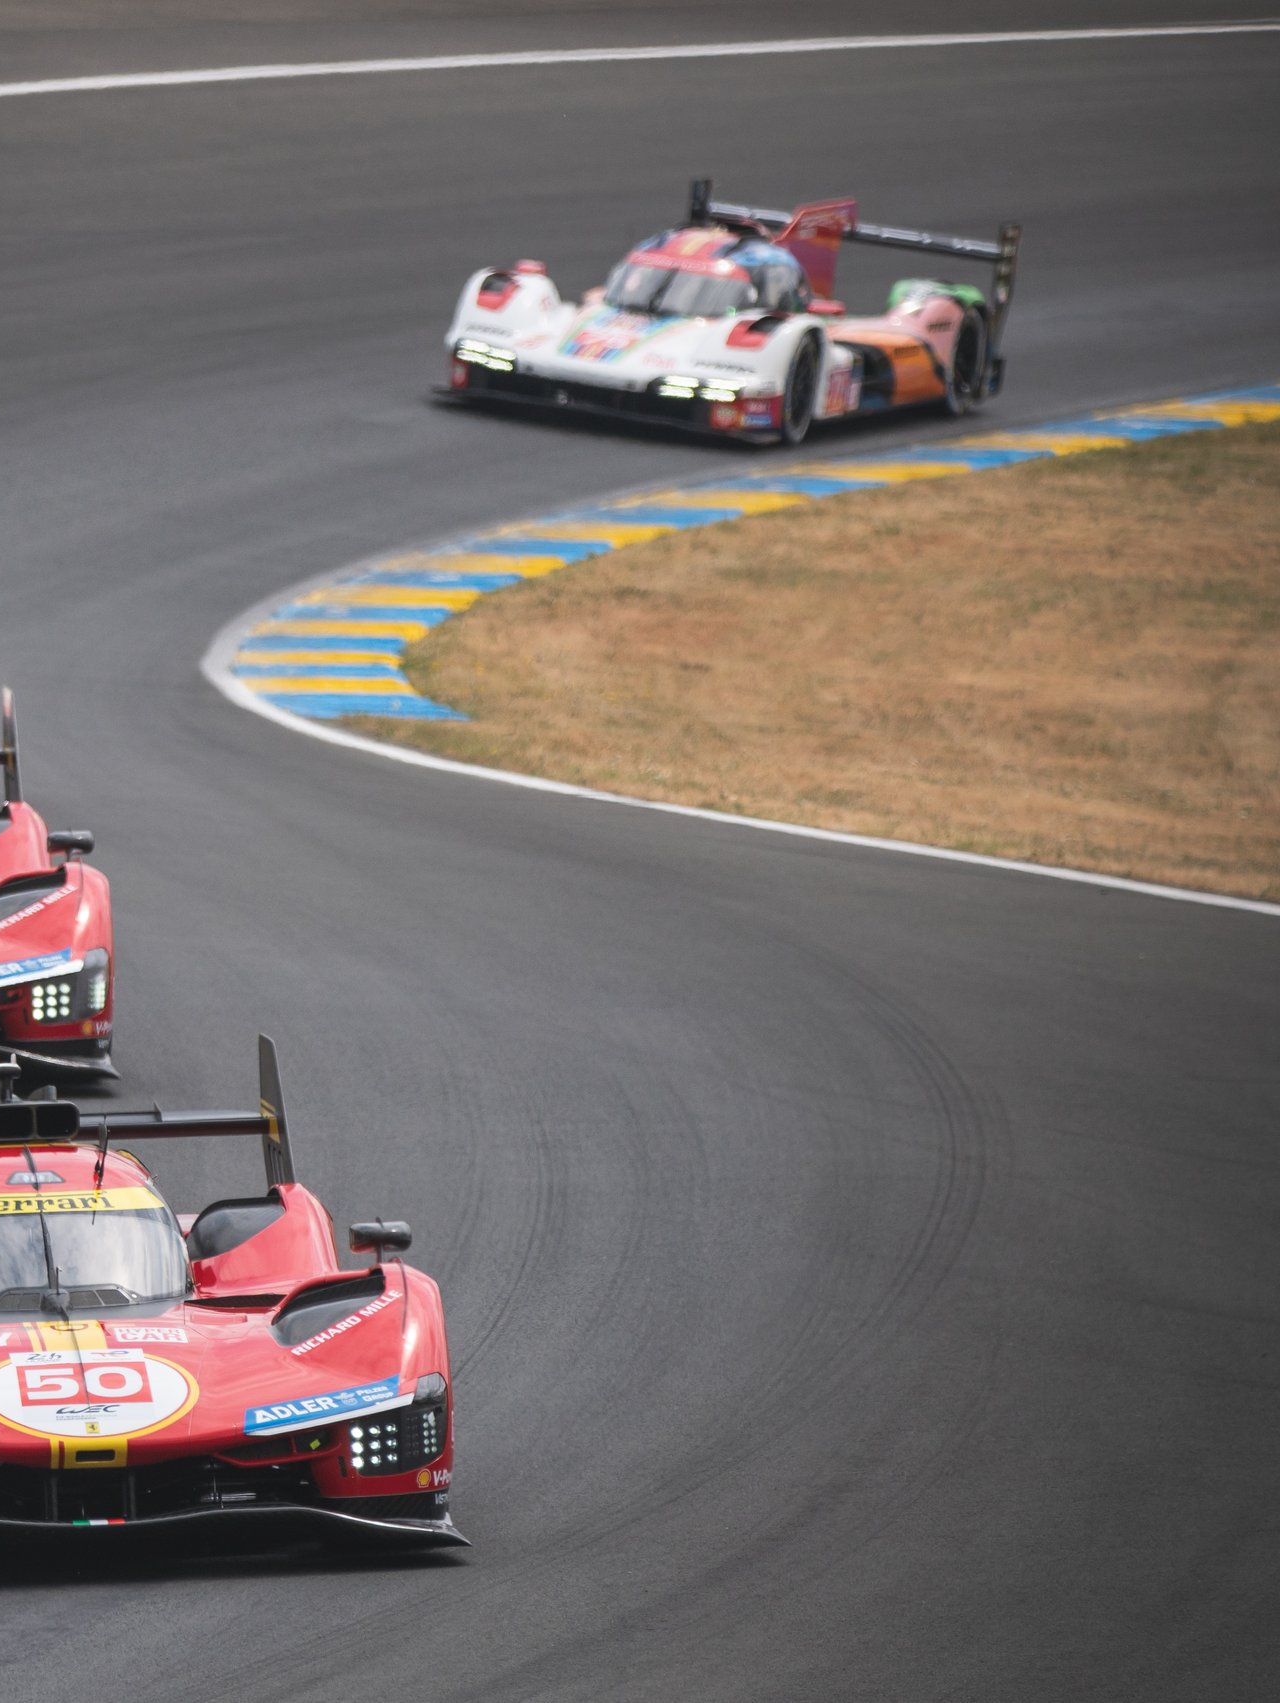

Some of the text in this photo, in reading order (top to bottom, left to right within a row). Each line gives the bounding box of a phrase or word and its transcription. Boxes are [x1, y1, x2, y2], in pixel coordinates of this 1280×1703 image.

[120, 1332, 183, 1341] CAR
[291, 1289, 404, 1356] RICHARD MILLE
[24, 1366, 144, 1400] 50
[56, 1404, 120, 1415] WEC
[254, 1396, 339, 1424] ADLER
